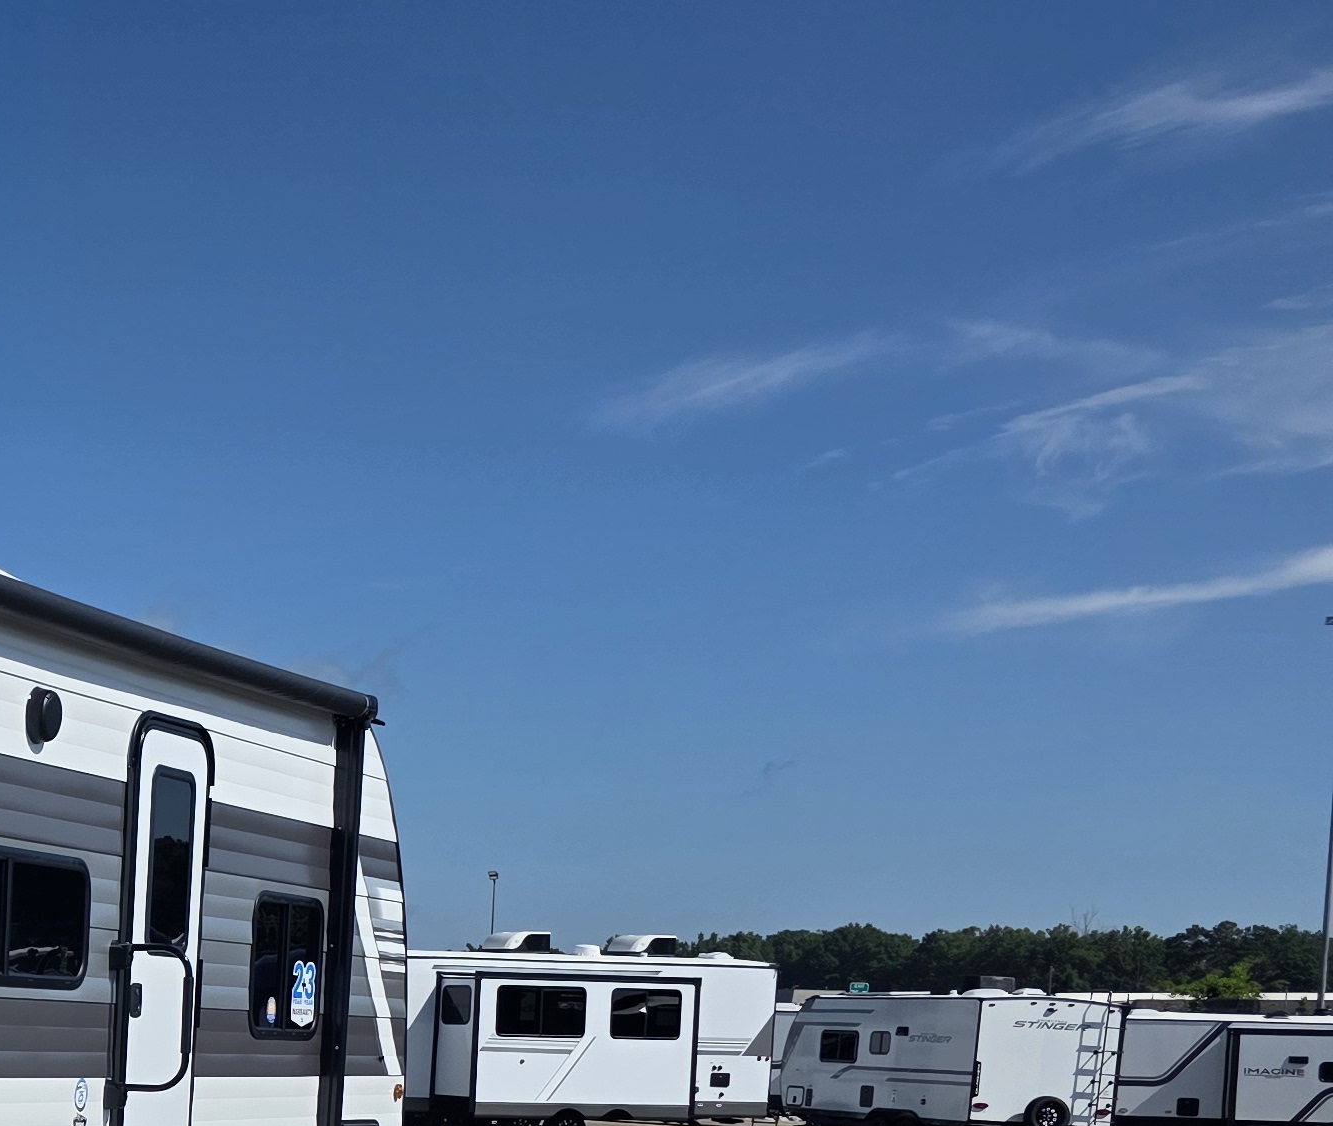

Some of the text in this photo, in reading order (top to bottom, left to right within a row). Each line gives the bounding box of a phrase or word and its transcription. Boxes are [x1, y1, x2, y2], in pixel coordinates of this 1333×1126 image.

[1013, 1020, 1092, 1032] STINGER
[908, 1034, 952, 1044] STINGER
[1243, 1067, 1305, 1077] IMAGINE
